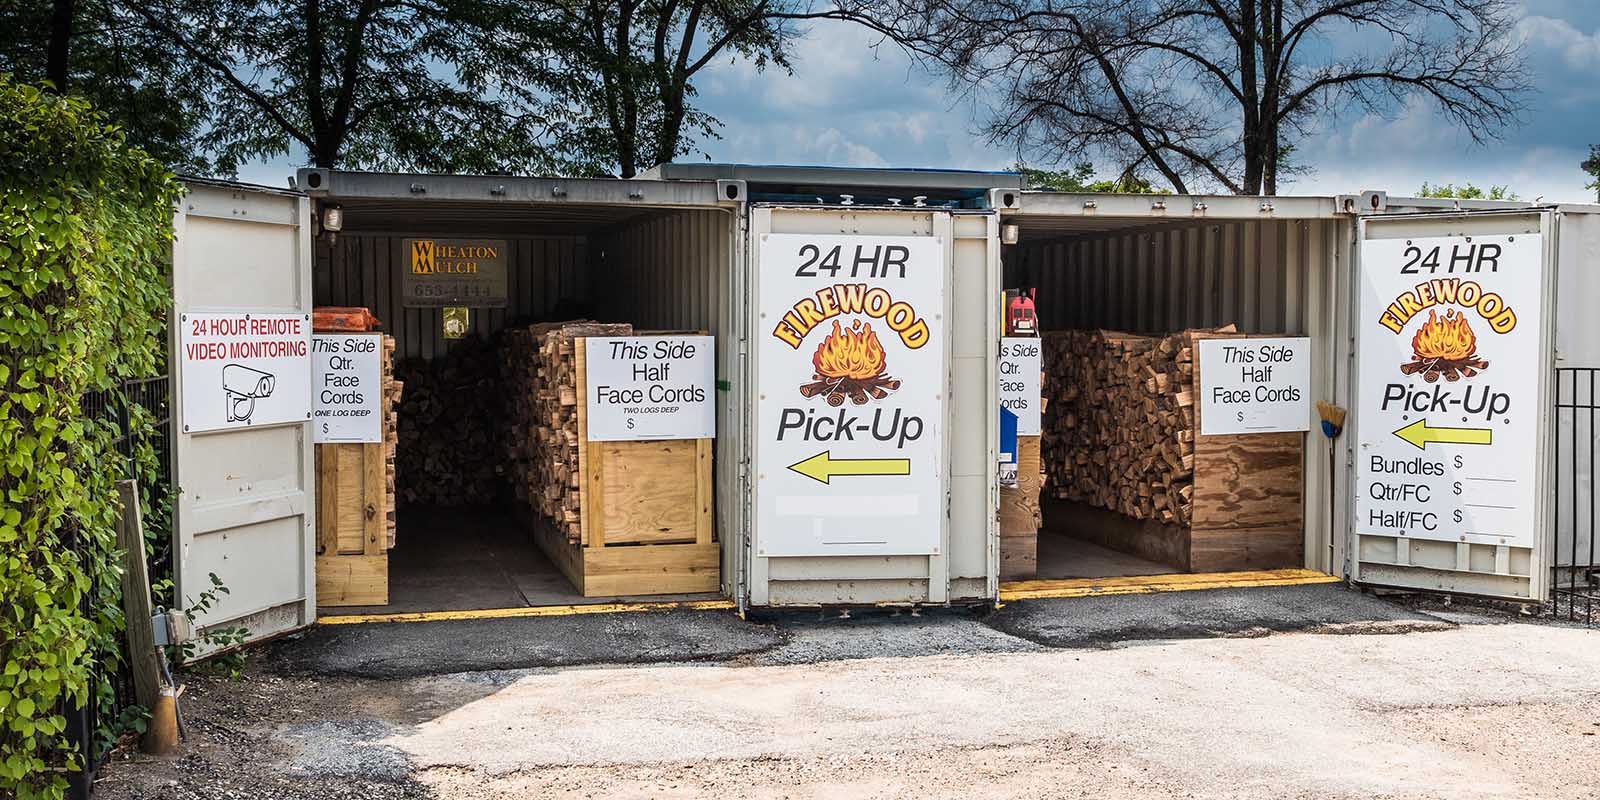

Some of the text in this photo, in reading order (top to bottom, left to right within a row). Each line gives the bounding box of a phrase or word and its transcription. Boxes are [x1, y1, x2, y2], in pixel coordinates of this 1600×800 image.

[413, 241, 497, 258] WHEATON
[414, 256, 478, 273] MULCH
[795, 245, 909, 278] 24 HR
[1400, 244, 1501, 274] 24 HR
[1379, 278, 1517, 335] FIREWOOD
[773, 284, 930, 349] FIREWOOD
[193, 319, 300, 336] 24 HOUR REMOTE
[187, 341, 306, 360] VIDEO MONITORING
[312, 339, 375, 353] This Side
[609, 341, 695, 359] This Side
[1012, 344, 1038, 357] Side
[1223, 346, 1293, 363] This Side
[330, 356, 354, 370] Qtr.
[1000, 361, 1021, 375] Qtr.
[325, 373, 359, 387] Face
[633, 363, 670, 381] Half
[1242, 366, 1272, 383] Half
[321, 390, 363, 404] Cords
[598, 384, 705, 404] Face Cords
[1214, 385, 1300, 403] Face Cords
[1382, 384, 1510, 421] Pick-Up
[660, 406, 680, 414] DEEP
[1000, 397, 1028, 409] ords
[627, 418, 634, 429] $
[1237, 411, 1244, 422] $
[322, 422, 329, 434] $
[777, 408, 923, 449] Pick-Up
[1371, 455, 1462, 476] Bundles $
[1370, 481, 1462, 502] Qtr/FC $
[1370, 509, 1462, 529] Half/FC $
